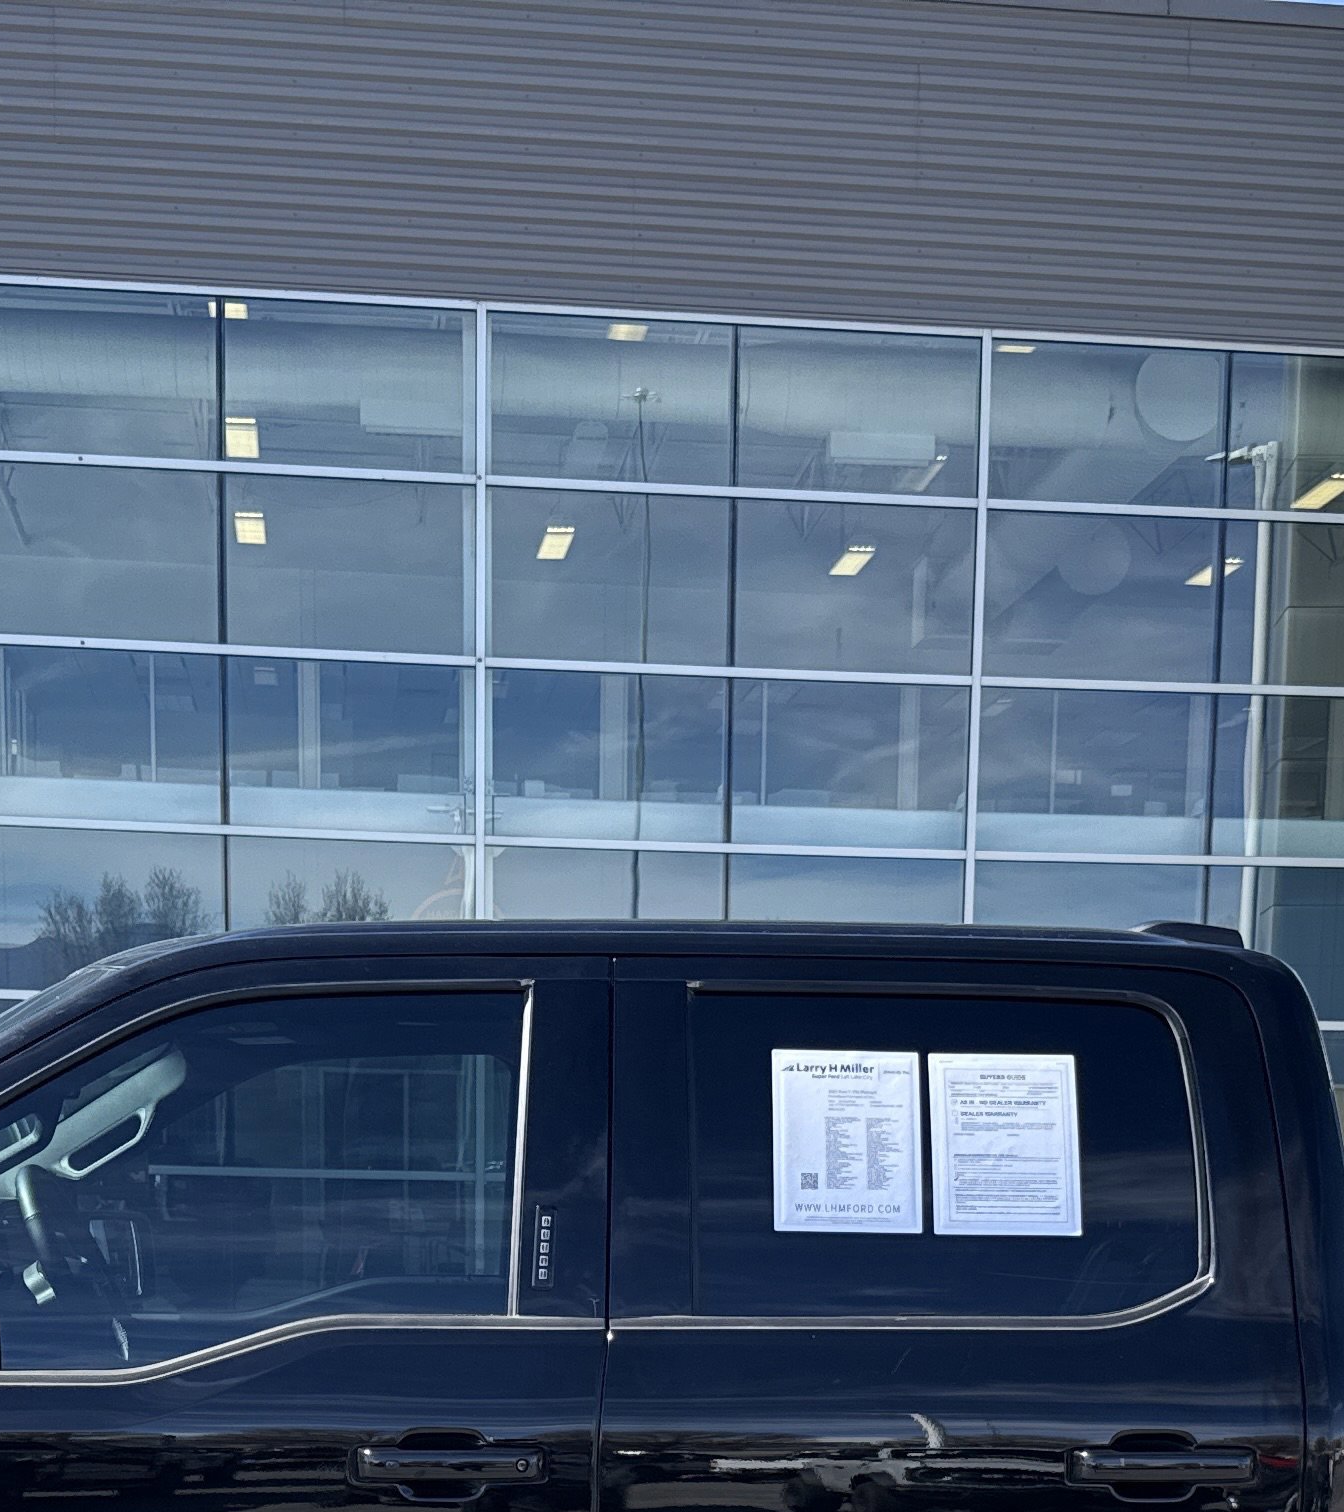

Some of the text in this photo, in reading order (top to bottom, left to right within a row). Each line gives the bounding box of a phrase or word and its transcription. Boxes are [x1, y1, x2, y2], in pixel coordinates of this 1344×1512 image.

[796, 1063, 827, 1074] Larry
[828, 1063, 838, 1073] H
[840, 1063, 874, 1074] Miller
